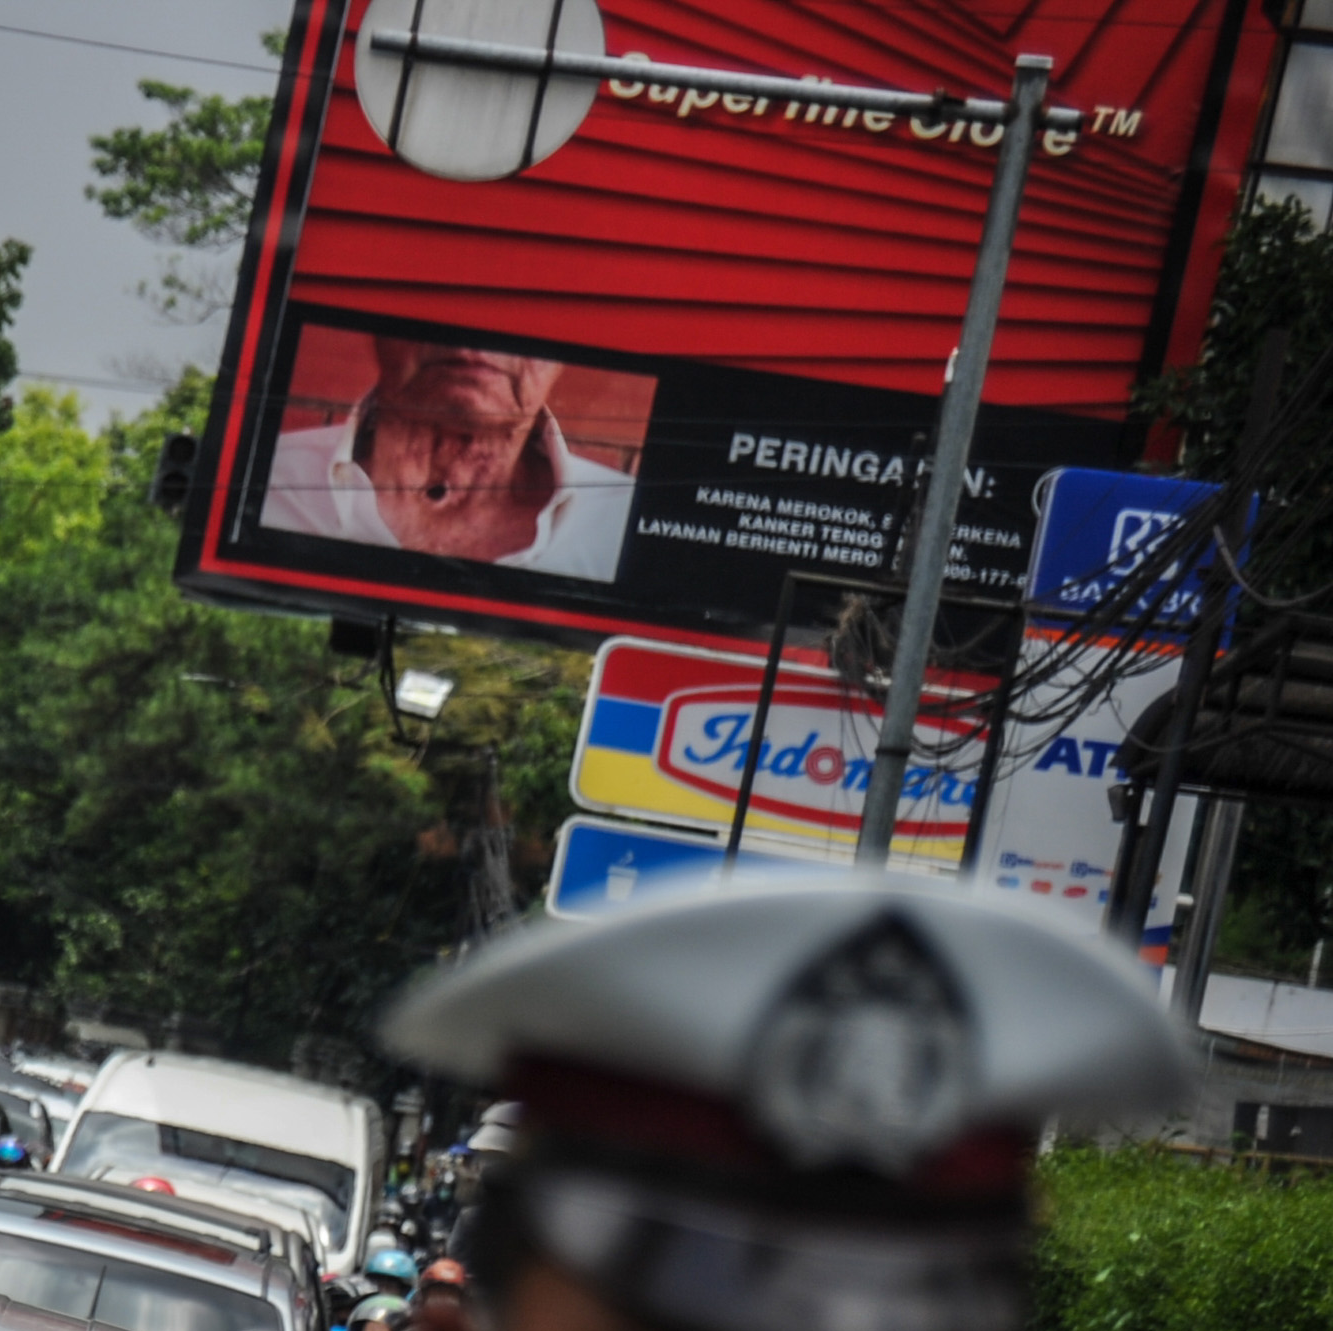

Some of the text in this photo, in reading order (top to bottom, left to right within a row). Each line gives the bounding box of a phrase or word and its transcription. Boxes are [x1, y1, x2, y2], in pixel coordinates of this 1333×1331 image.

[695, 486, 771, 513] KARENA
[776, 498, 877, 531] MEROKOK,
[738, 512, 814, 540] KANKER
[637, 517, 722, 545] LAYANAN
[725, 529, 818, 560] BERHENTI
